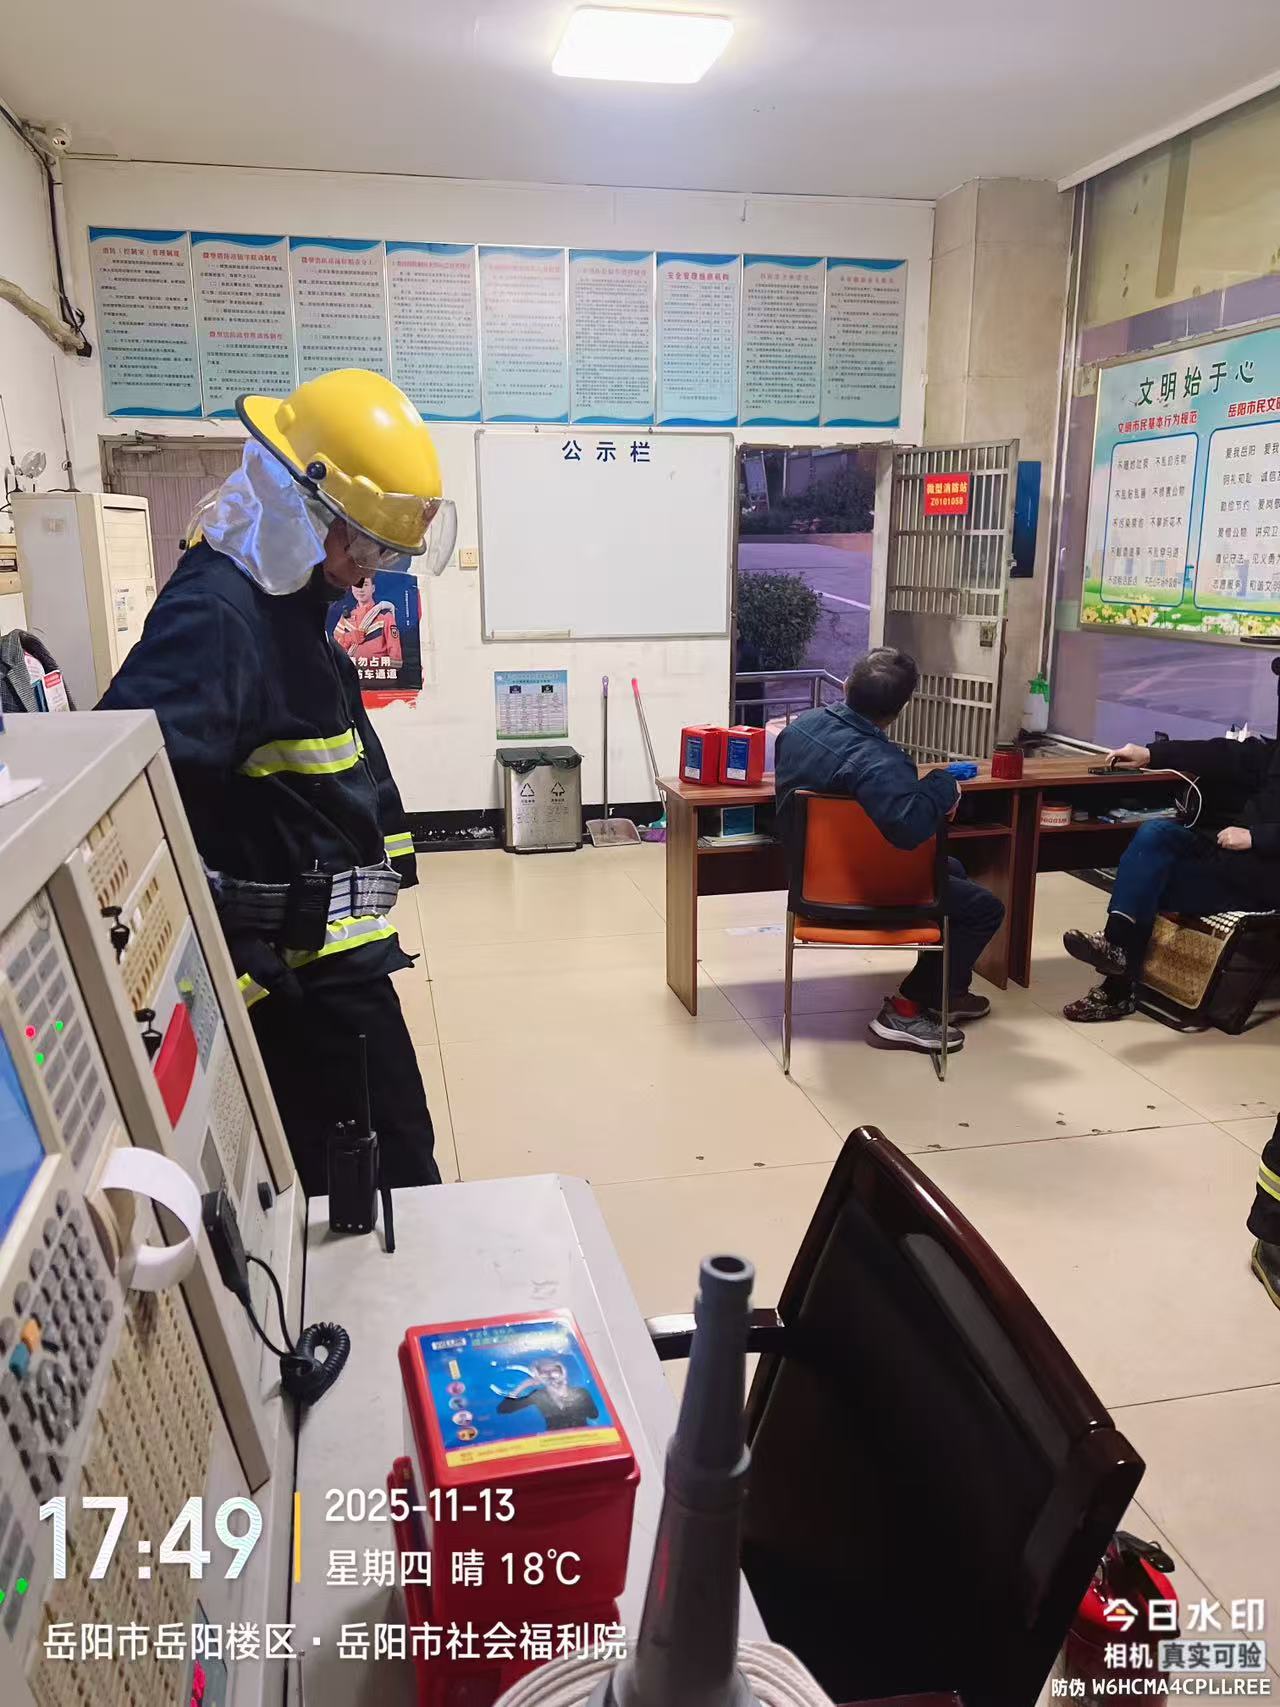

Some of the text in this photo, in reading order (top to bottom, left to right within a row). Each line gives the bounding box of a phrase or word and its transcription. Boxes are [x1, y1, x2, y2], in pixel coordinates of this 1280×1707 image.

[1137, 361, 1254, 406] 文明始于心
[1118, 410, 1198, 433] 文明市民基本行为规范
[562, 440, 650, 462] 公示栏
[1225, 444, 1256, 459] 爱我岳阳
[1217, 527, 1248, 538] 爱惜公物
[1215, 553, 1244, 564] 遵纪守法
[350, 656, 391, 667] 勿占用
